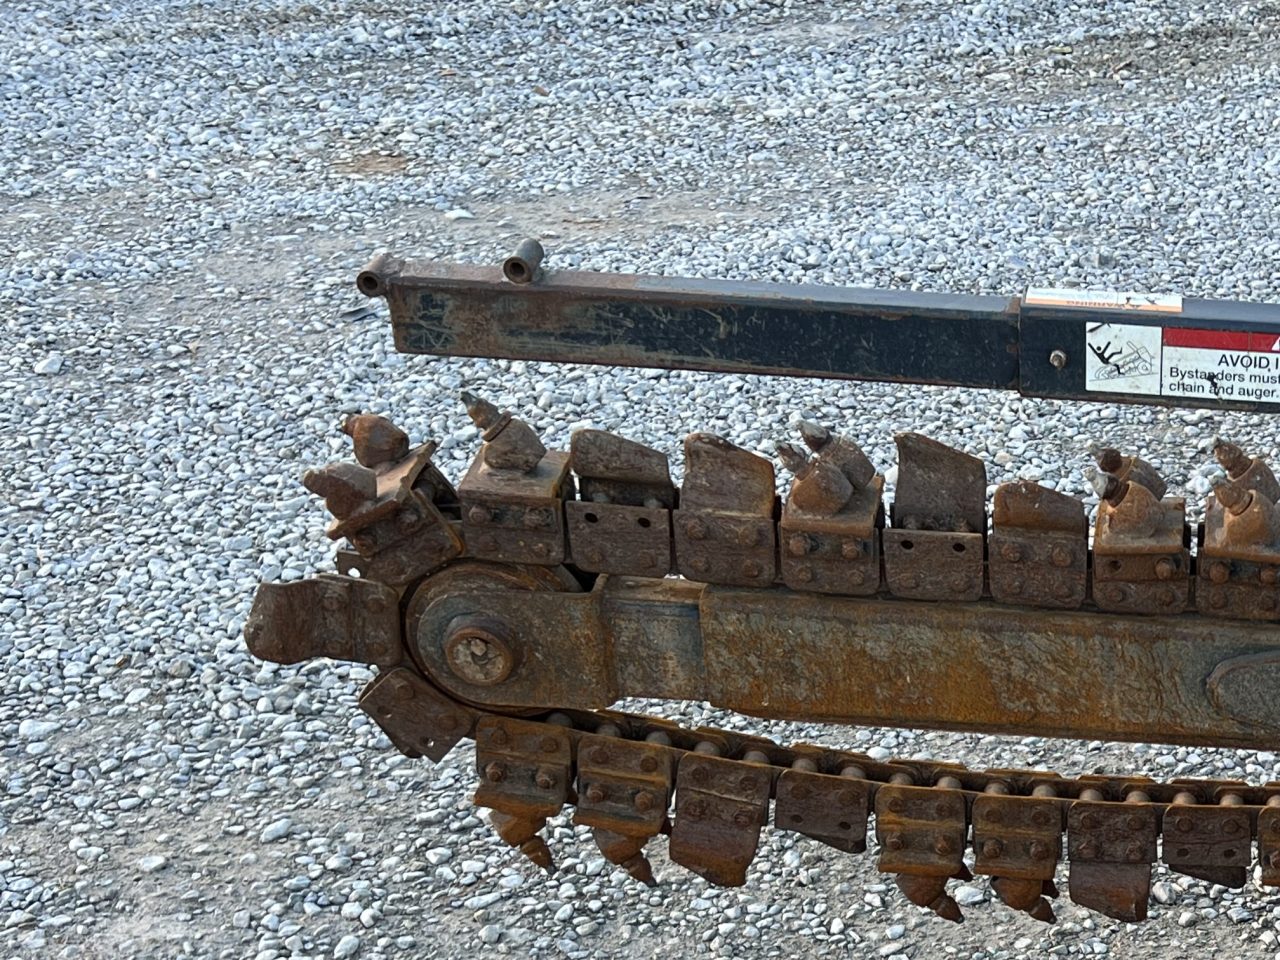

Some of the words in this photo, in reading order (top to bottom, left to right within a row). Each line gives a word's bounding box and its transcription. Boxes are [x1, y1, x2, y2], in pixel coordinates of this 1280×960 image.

[1217, 354, 1270, 370] AVOID
[1169, 367, 1246, 383] Bystanders
[1168, 380, 1205, 394] chain
[1208, 384, 1234, 396] and
[1237, 386, 1280, 400] auger.
